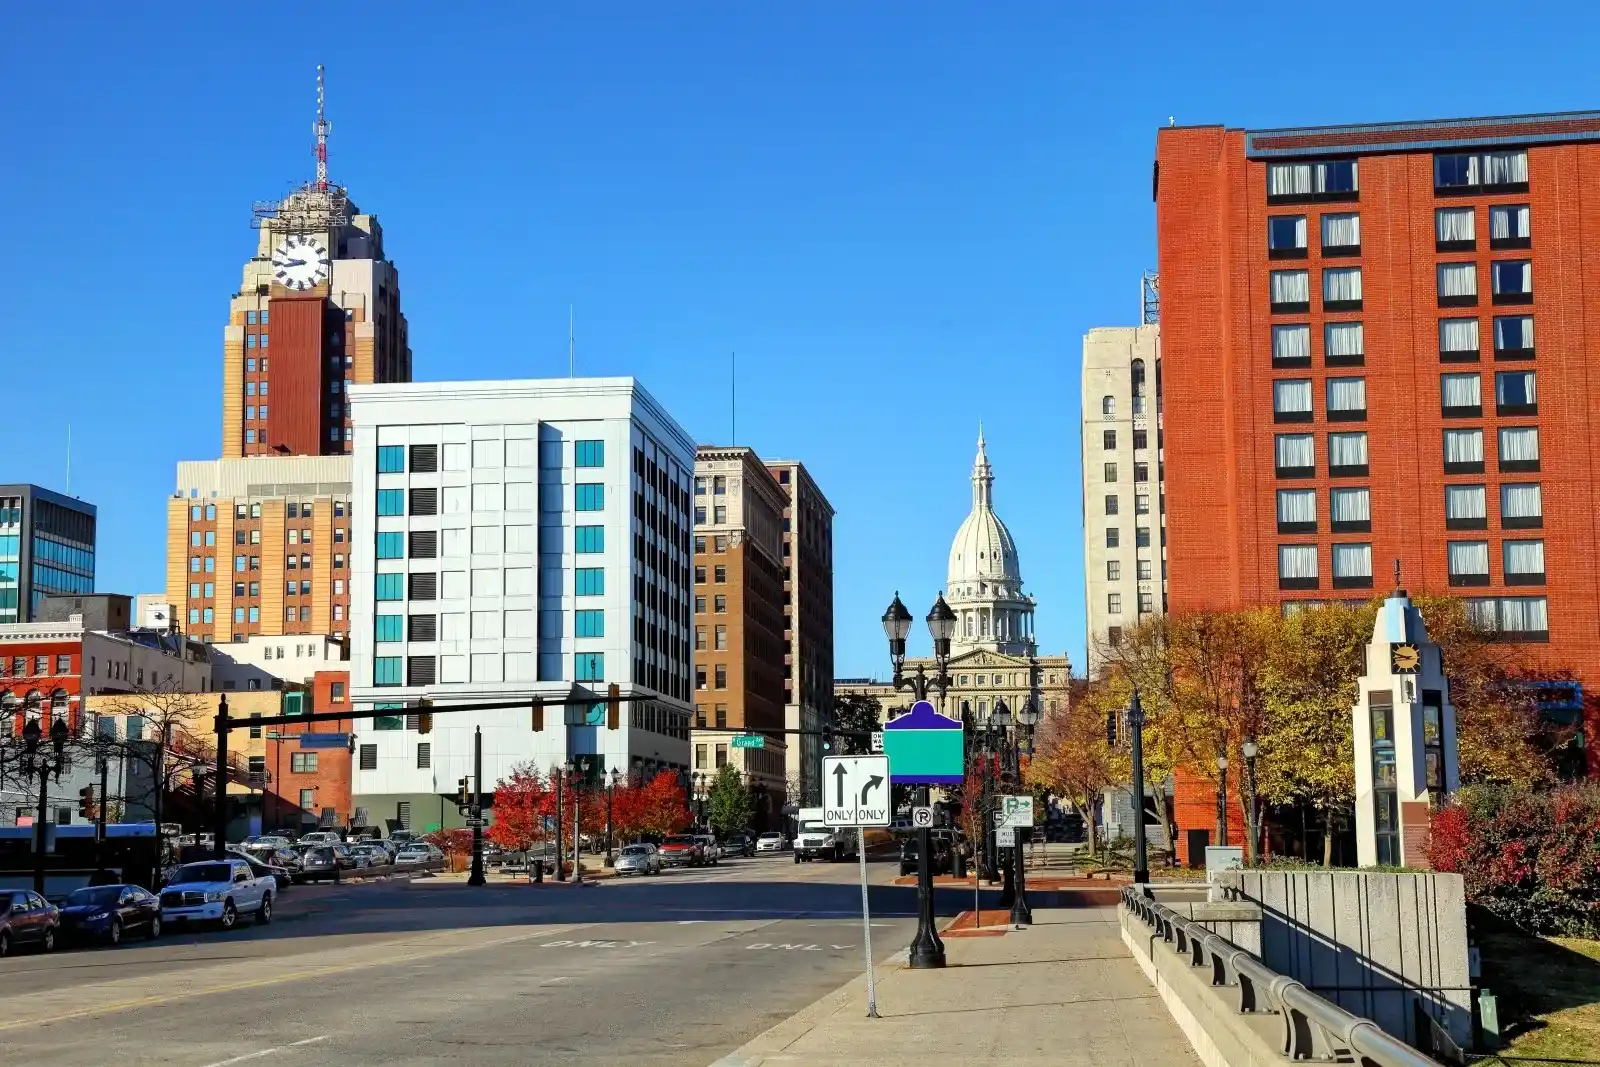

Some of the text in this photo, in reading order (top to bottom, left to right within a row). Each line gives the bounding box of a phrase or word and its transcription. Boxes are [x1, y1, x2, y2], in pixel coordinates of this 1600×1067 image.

[736, 738, 755, 747] Grand
[827, 810, 854, 821] ONLY
[859, 809, 886, 820] ONLY
[540, 940, 657, 948] ONLY
[745, 943, 857, 951] ONLY
